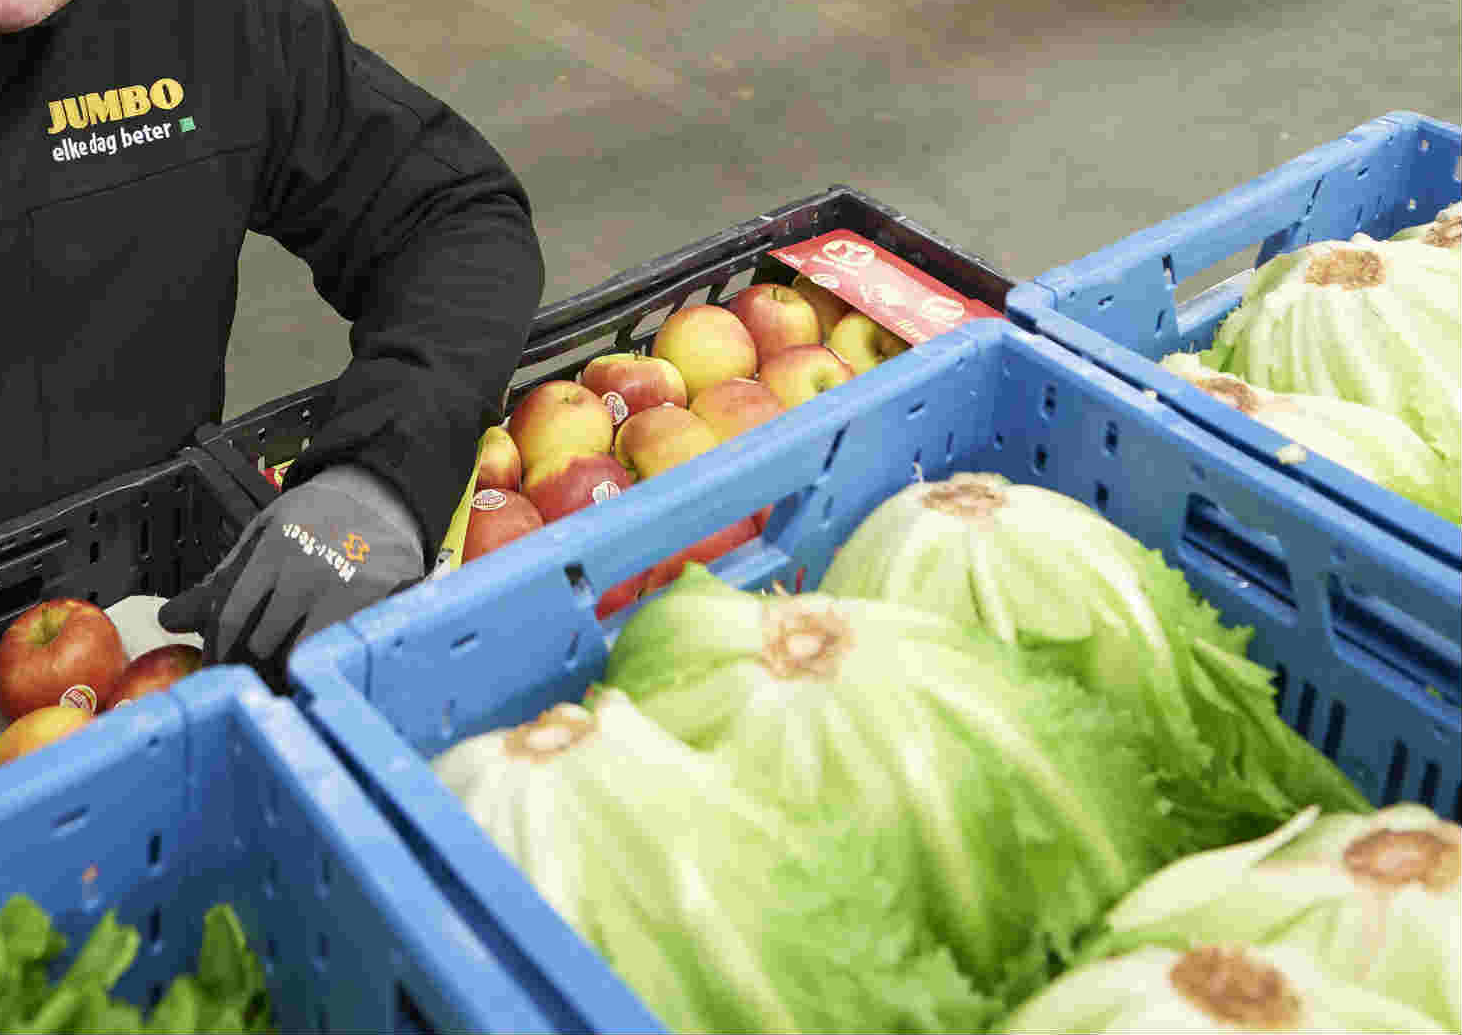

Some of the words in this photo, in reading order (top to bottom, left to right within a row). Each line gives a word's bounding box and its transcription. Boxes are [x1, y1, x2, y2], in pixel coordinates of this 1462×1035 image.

[47, 77, 185, 135] JUMBO
[52, 136, 88, 163] elke
[89, 132, 118, 156] dag
[120, 121, 172, 149] beter
